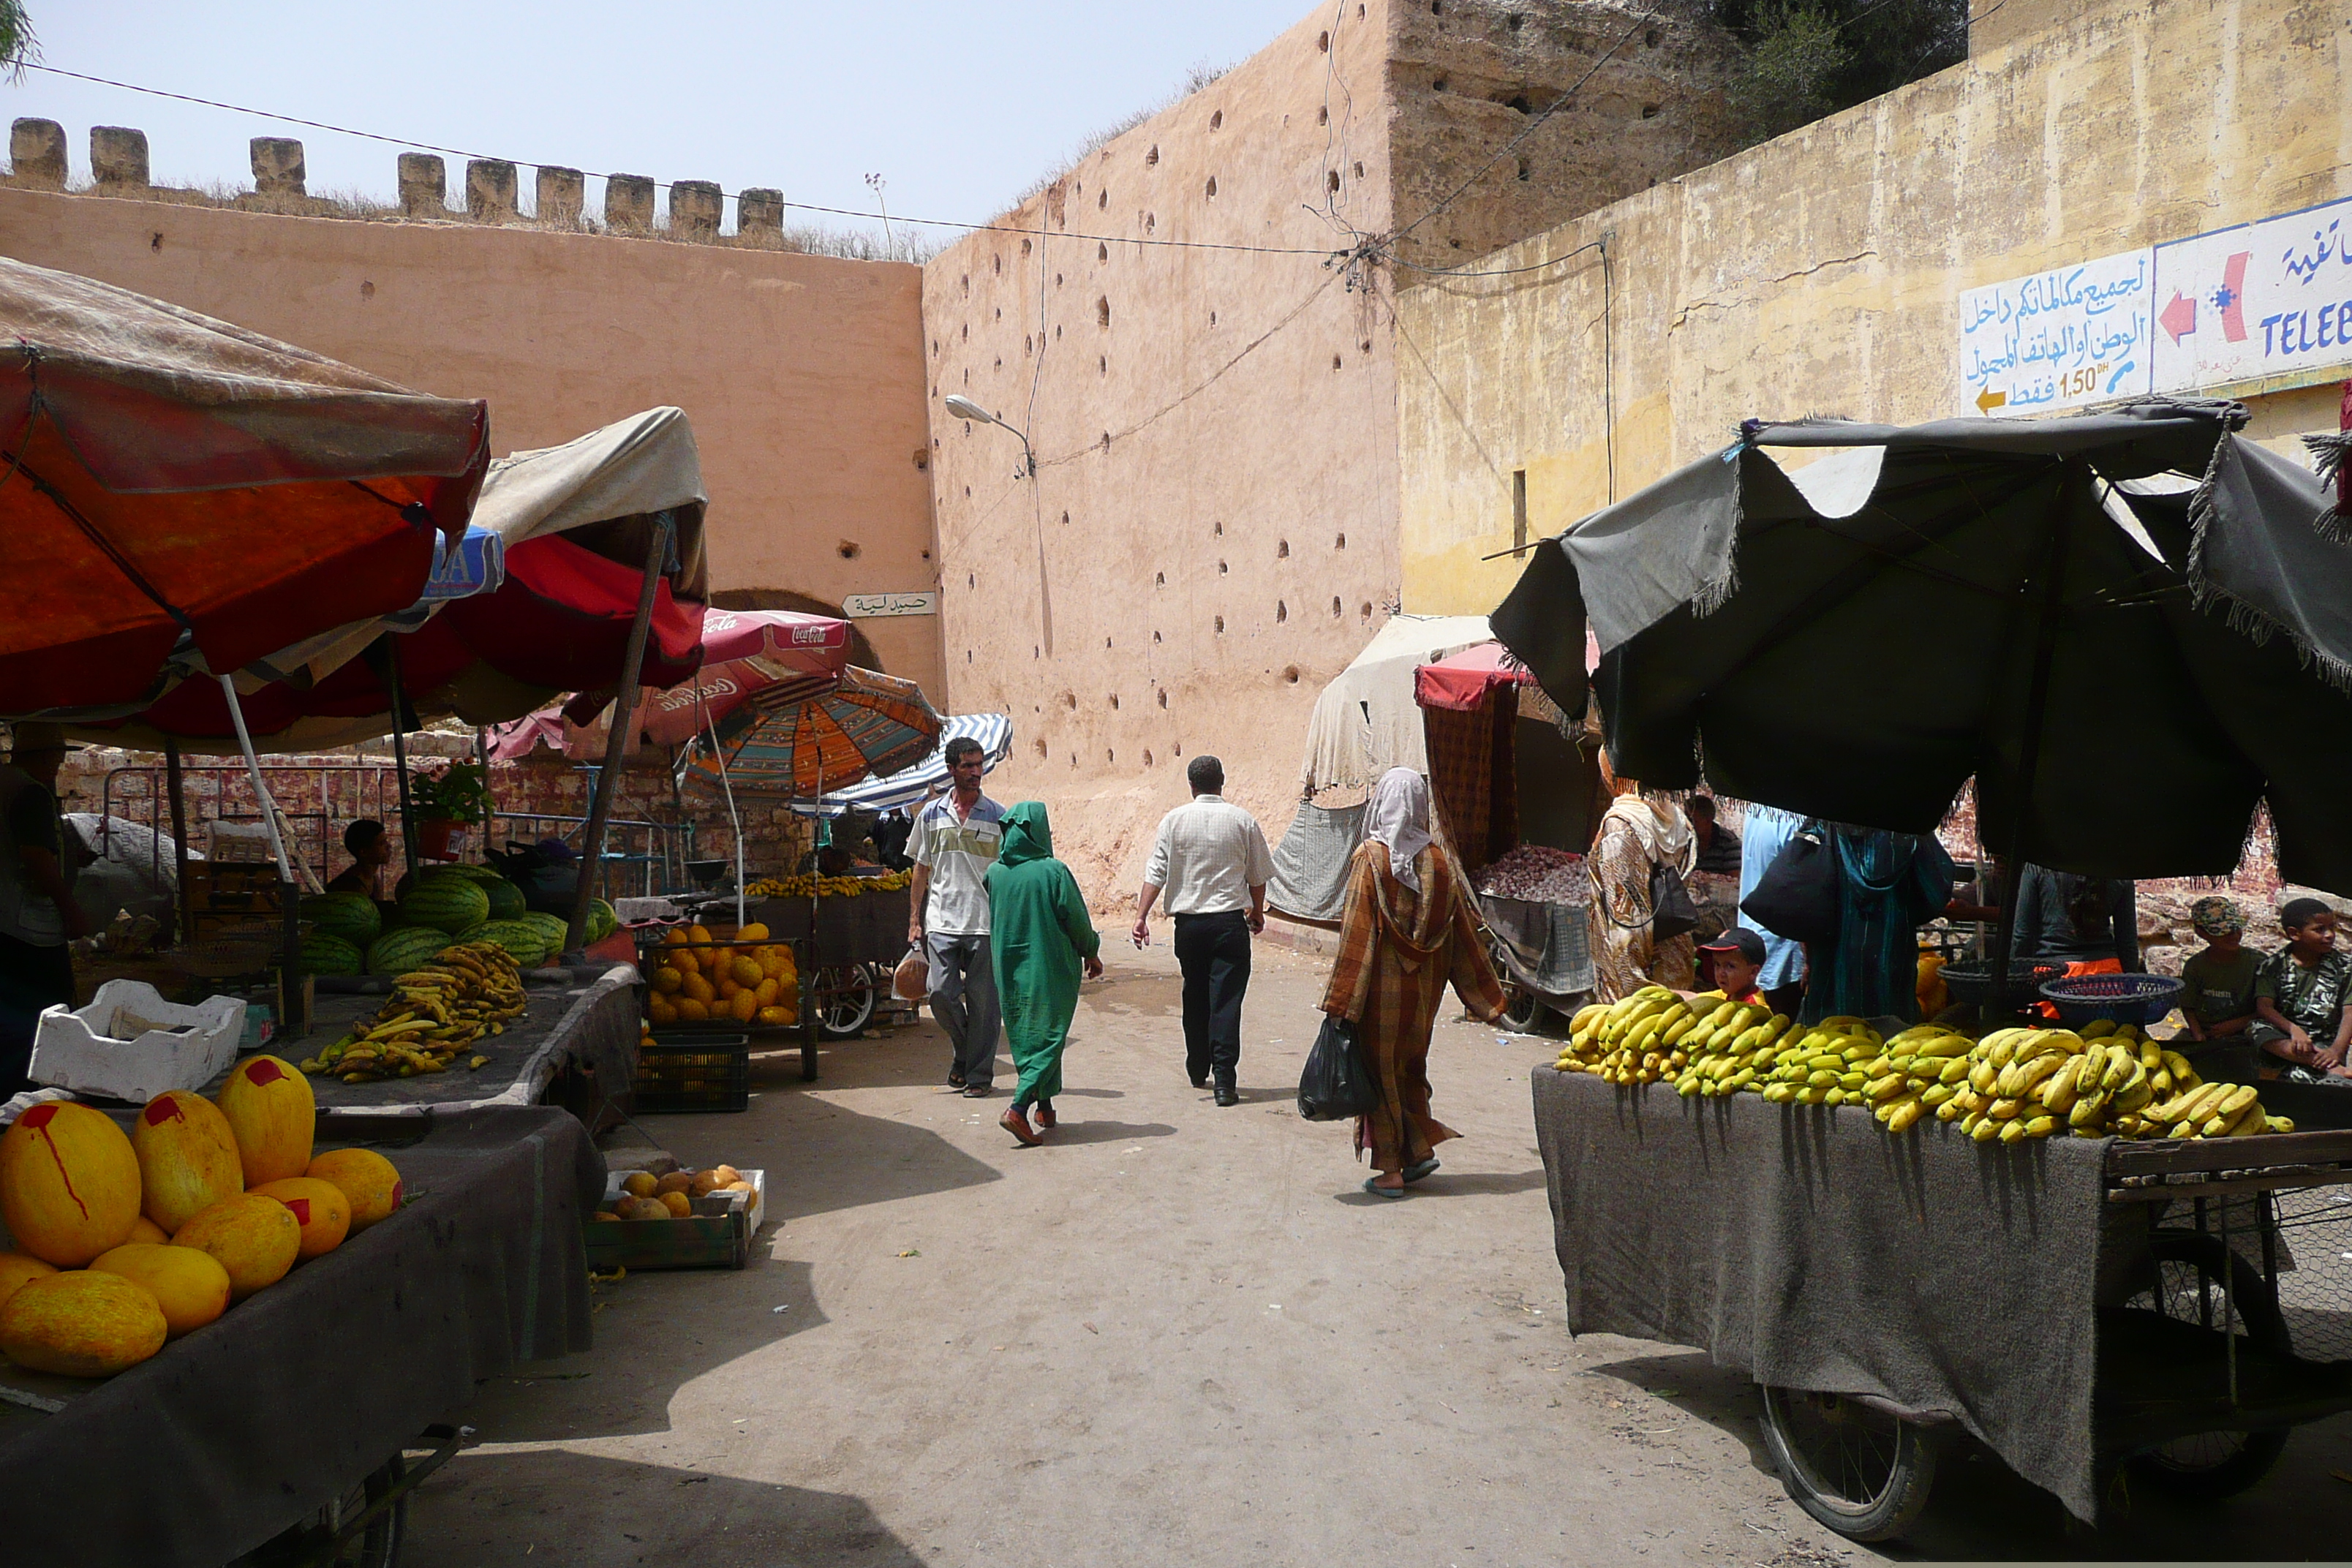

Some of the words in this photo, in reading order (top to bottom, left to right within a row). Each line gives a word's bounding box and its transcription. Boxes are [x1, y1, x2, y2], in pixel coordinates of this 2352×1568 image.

[2282, 219, 2352, 286] اتفية
[1965, 288, 2011, 333] داخل
[2015, 268, 2084, 340] مكالماتكم
[2084, 255, 2145, 316] لجميع
[1967, 332, 2019, 387] المحمول
[2021, 323, 2075, 368] الهاتف
[2091, 311, 2146, 361] الوطن
[2009, 375, 2054, 406] فقط
[2097, 362, 2109, 374] DH
